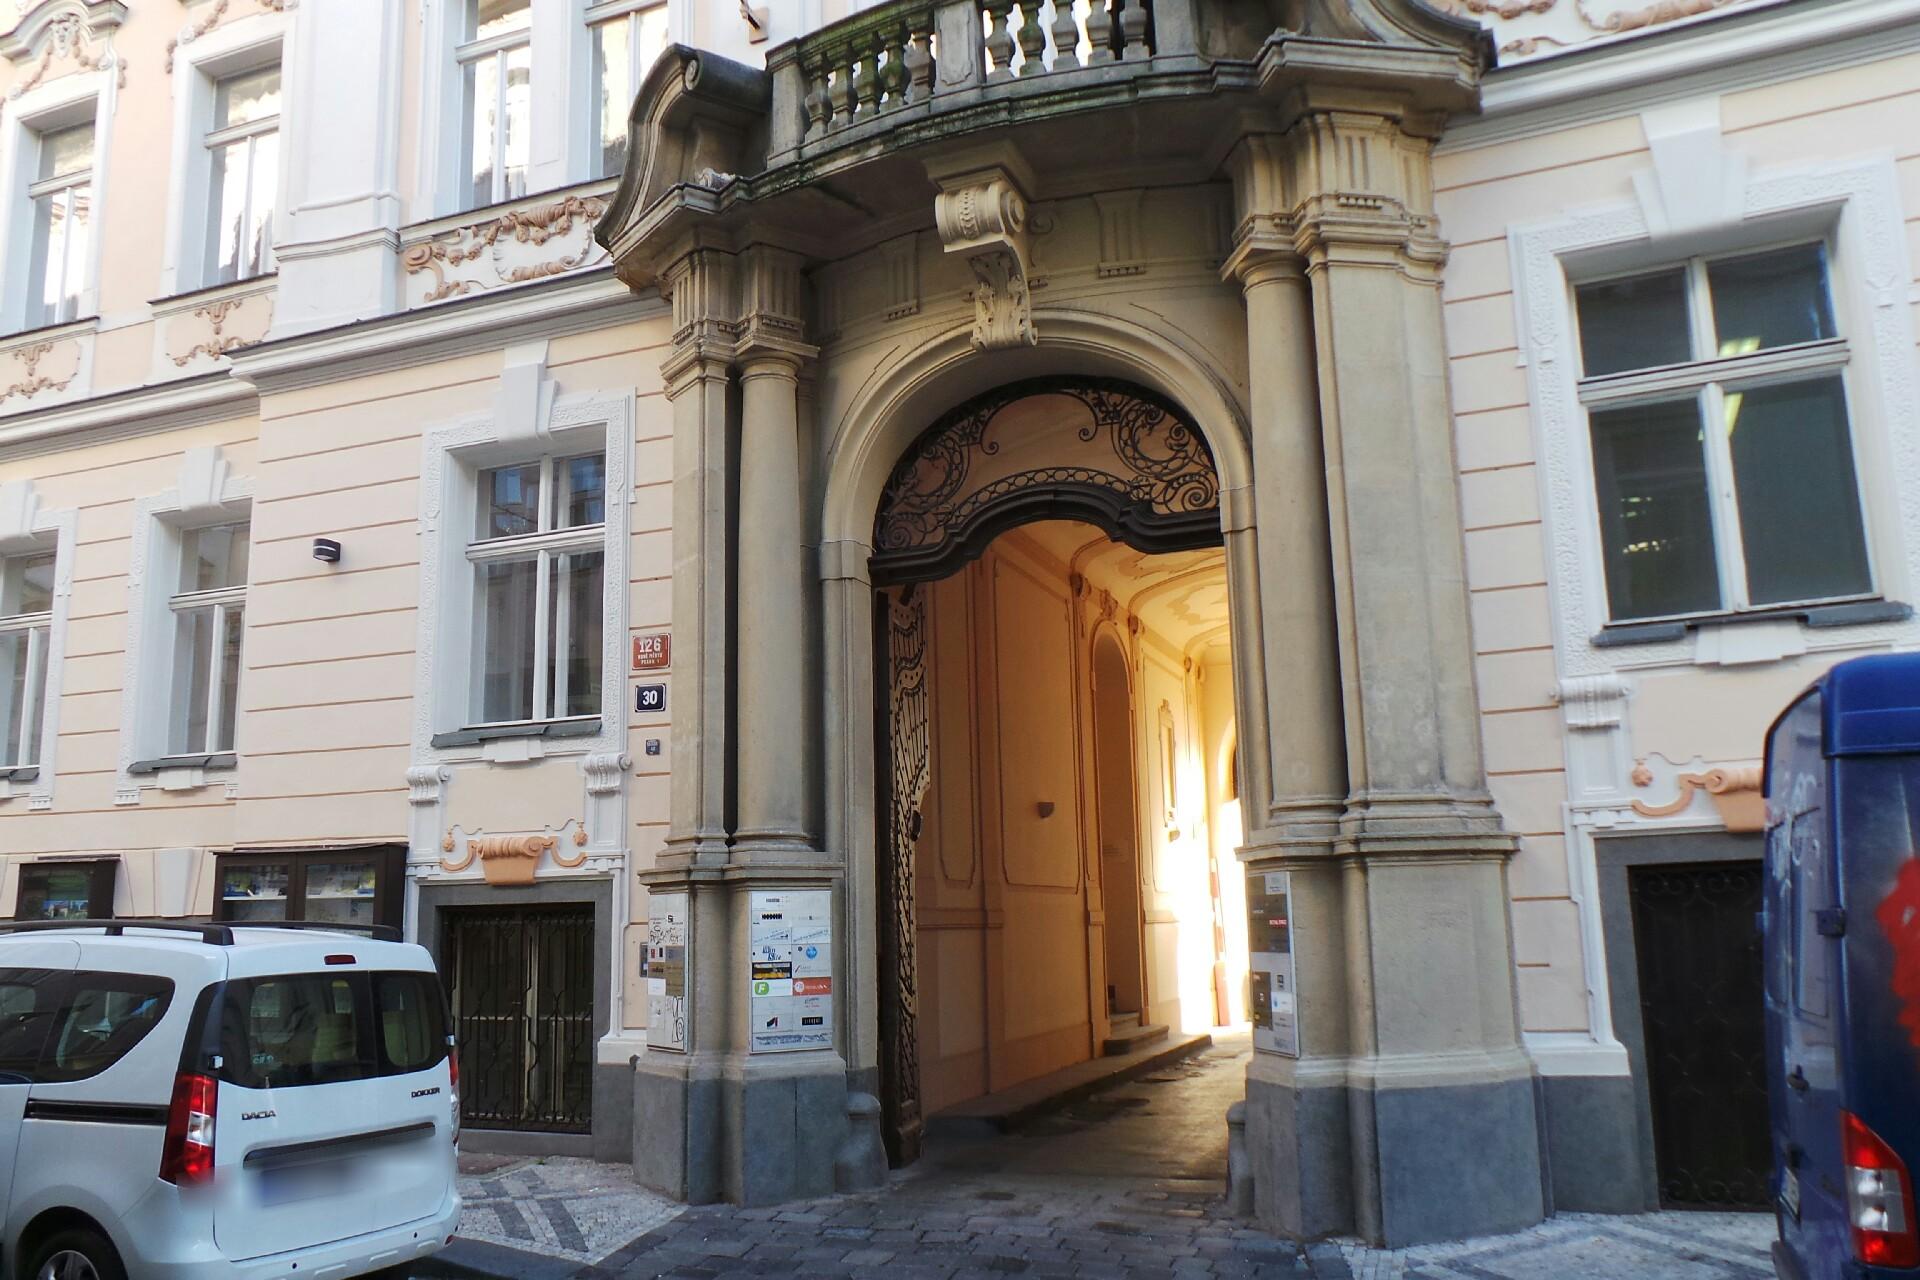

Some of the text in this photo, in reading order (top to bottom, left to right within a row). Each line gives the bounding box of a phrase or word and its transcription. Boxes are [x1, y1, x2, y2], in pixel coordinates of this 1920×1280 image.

[639, 638, 661, 652] 126
[642, 690, 658, 705] 30
[411, 1087, 440, 1098] DOKKER
[241, 1110, 277, 1121] DACIA
